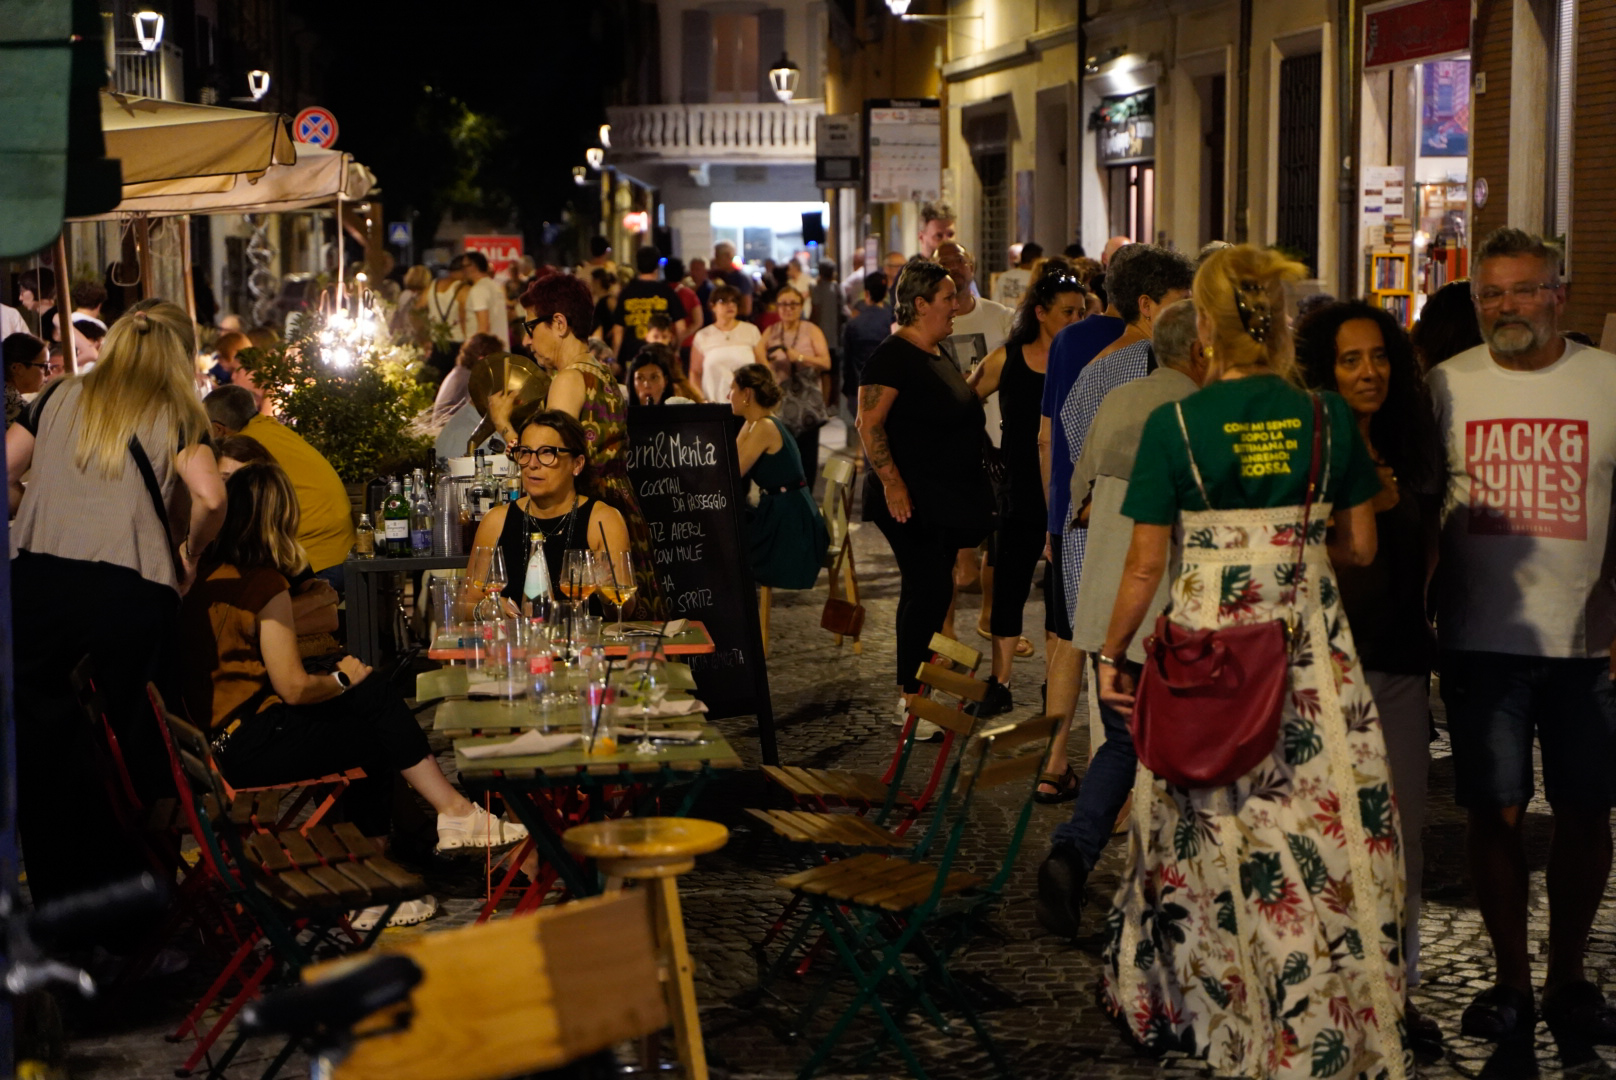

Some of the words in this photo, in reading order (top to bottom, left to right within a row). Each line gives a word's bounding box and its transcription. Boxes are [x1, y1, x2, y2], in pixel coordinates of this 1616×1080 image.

[1270, 431, 1284, 440] LA
[1285, 440, 1297, 450] DI
[1469, 422, 1583, 463] JACK&
[625, 430, 717, 471] erri&Menta
[639, 475, 685, 497] COCKTAIL
[672, 496, 686, 513] DA
[671, 522, 706, 541] APEROL
[675, 543, 703, 562] MULE
[677, 587, 713, 613] SPRITZ
